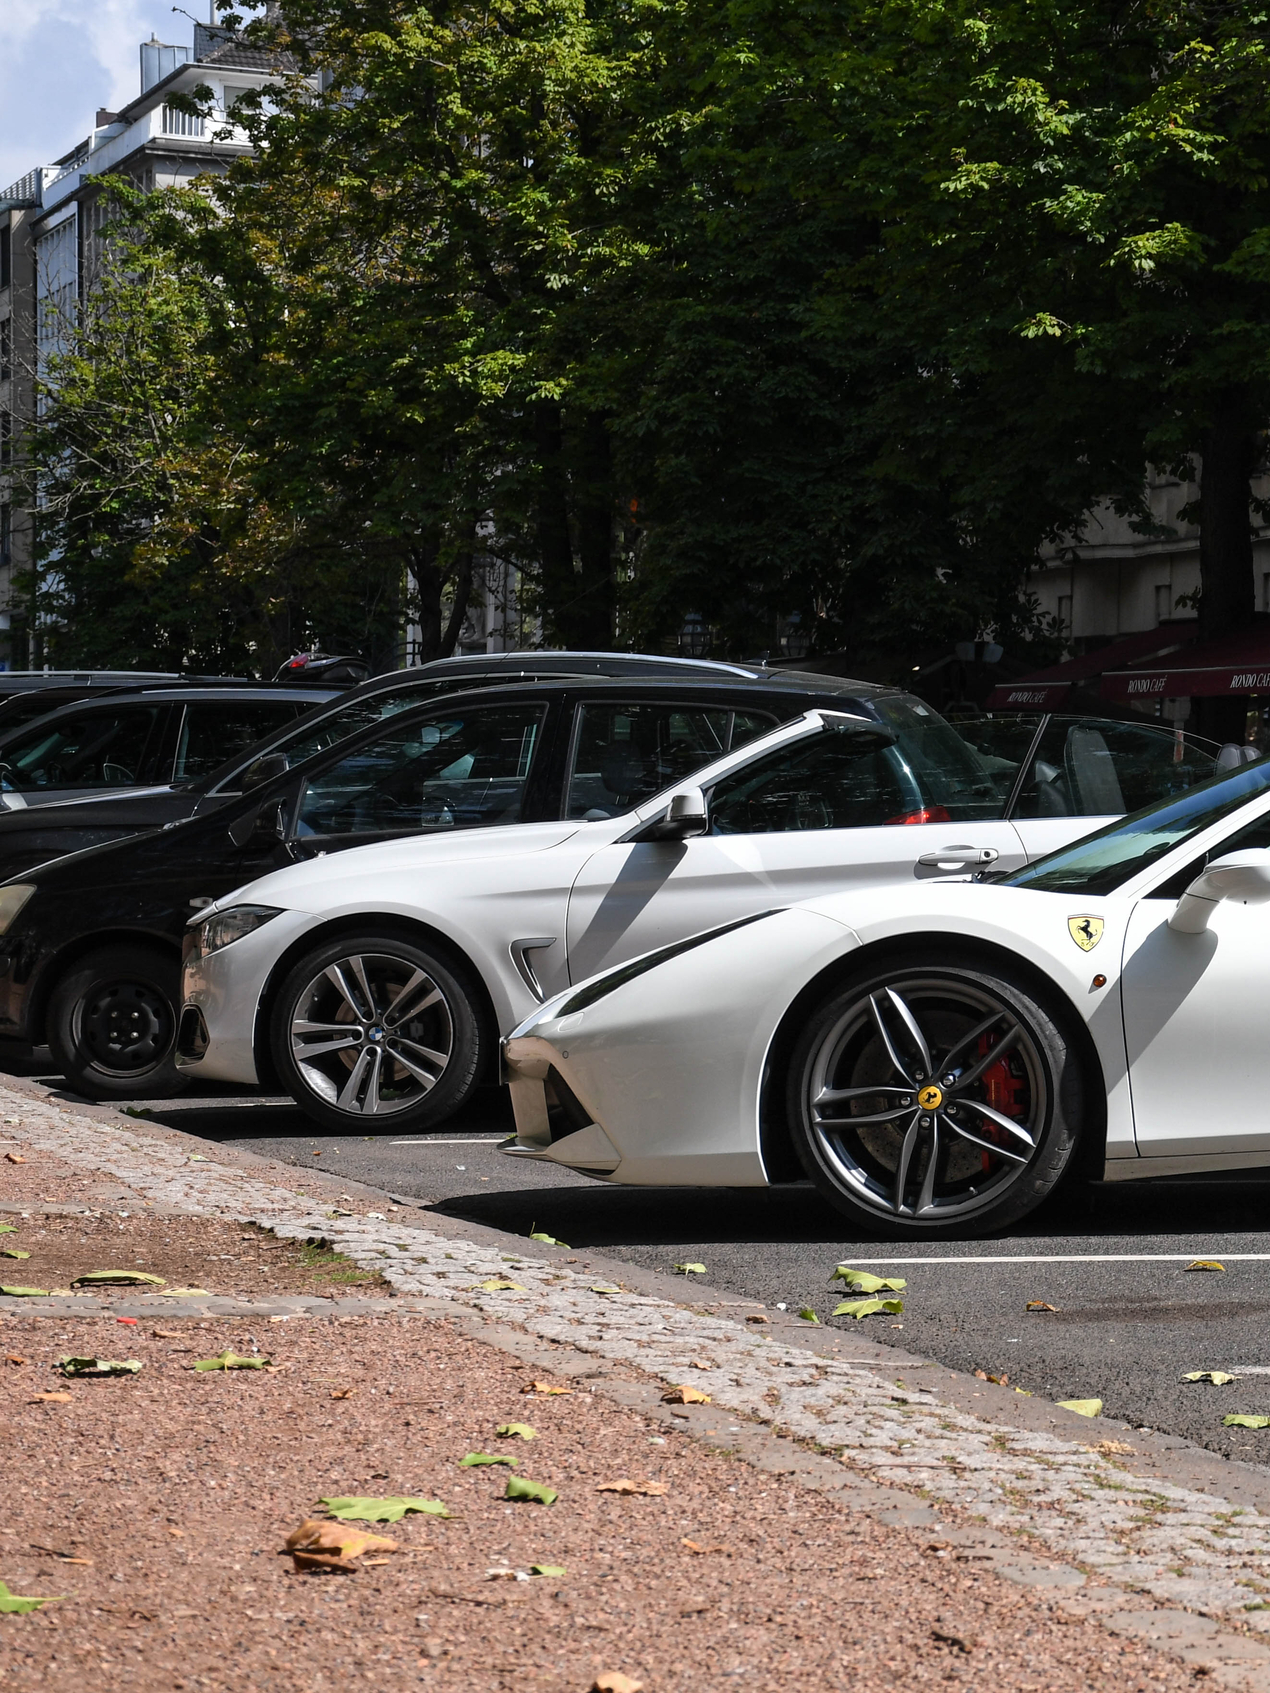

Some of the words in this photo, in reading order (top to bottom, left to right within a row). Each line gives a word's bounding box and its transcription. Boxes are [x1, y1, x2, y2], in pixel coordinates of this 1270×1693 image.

[1127, 679, 1151, 694] RONDO
[1150, 674, 1168, 692] CAFÉ
[1229, 673, 1257, 689] RONDO
